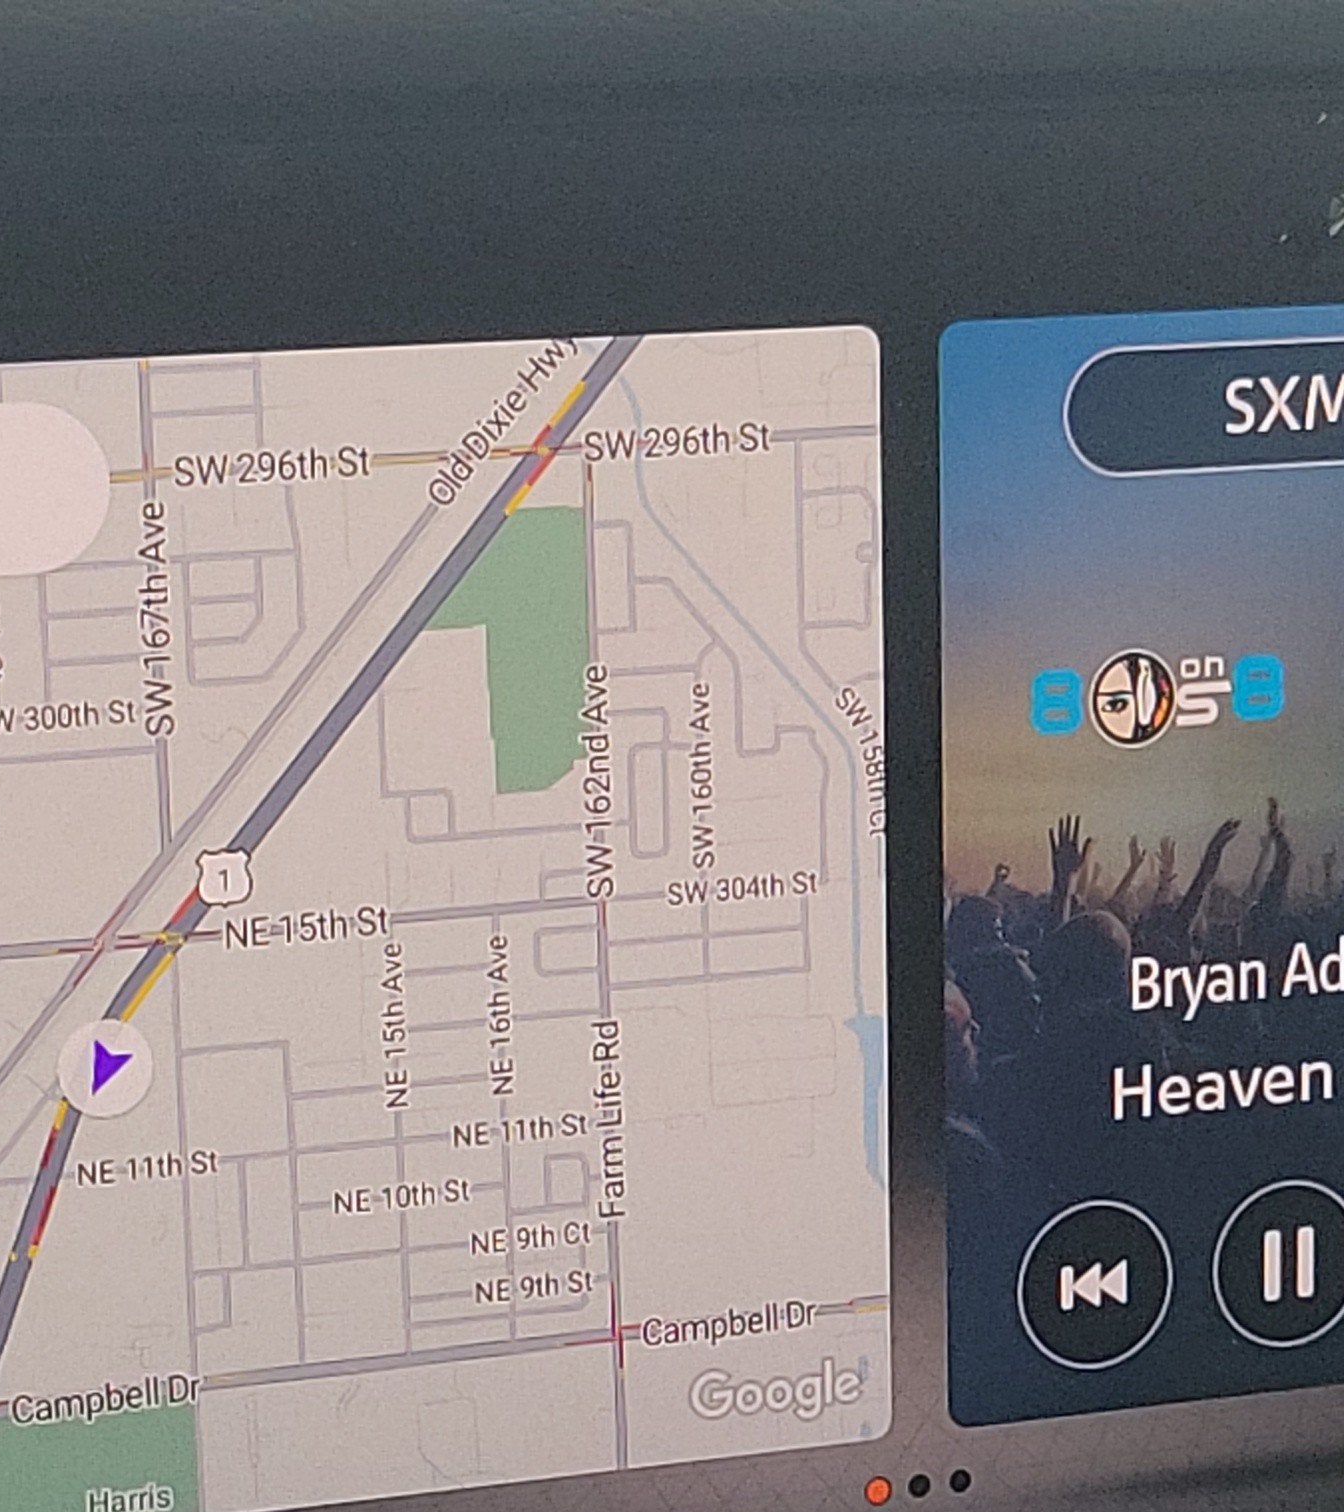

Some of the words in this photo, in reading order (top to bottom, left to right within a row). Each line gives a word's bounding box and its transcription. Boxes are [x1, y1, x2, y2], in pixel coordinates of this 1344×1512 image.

[429, 452, 474, 505] Old
[462, 390, 526, 460] Dixie
[518, 339, 578, 392] Hwy
[585, 431, 636, 461] SW
[643, 425, 730, 458] 296th
[739, 423, 770, 451] St
[174, 454, 228, 487] SW
[236, 447, 327, 483] 296th
[338, 447, 370, 477] St
[138, 502, 166, 563] Ave
[140, 573, 170, 667] 167th
[144, 673, 175, 736] SW
[582, 665, 608, 725] Ave
[689, 683, 709, 731] Ave
[836, 688, 872, 727] SW
[1232, 653, 1285, 721] 8
[24, 704, 100, 730] 300th
[109, 702, 136, 727] St
[582, 735, 611, 834] 162nd
[689, 741, 712, 815] 160th
[692, 825, 714, 869] SW
[220, 869, 230, 890] 1
[586, 845, 614, 898] SW
[668, 882, 707, 905] SW
[717, 873, 784, 900] 304th
[793, 871, 818, 895] St
[226, 917, 270, 949] NE
[279, 909, 347, 943] 15th
[357, 906, 387, 936] St
[382, 943, 404, 994] Ave
[488, 935, 509, 982] Ave
[1131, 956, 1266, 1022] Bryan
[381, 1002, 406, 1057] 15th
[488, 991, 511, 1048] 16th
[591, 1021, 620, 1062] Rd
[385, 1069, 408, 1108] NE
[490, 1057, 513, 1095] NE
[594, 1071, 622, 1128] Life
[1111, 1058, 1333, 1122] Heaven
[453, 1124, 489, 1147] NE
[502, 1118, 553, 1141] 11th
[562, 1115, 588, 1138] St
[77, 1161, 115, 1186] NE
[128, 1153, 182, 1179] 11th
[192, 1151, 218, 1175] St
[598, 1136, 626, 1218] Farm
[333, 1190, 371, 1214] NE
[382, 1182, 435, 1209] 10th
[444, 1179, 469, 1202] St
[471, 1229, 506, 1255] NE
[516, 1225, 554, 1249] 9th
[564, 1222, 590, 1245] Ct
[475, 1280, 510, 1303] NE
[520, 1274, 557, 1299] 9th
[568, 1272, 593, 1294] St
[642, 1311, 779, 1346] Campbell
[786, 1302, 817, 1330] Dr
[11, 1382, 160, 1425] Campbell
[167, 1375, 201, 1405] Dr
[690, 1358, 860, 1421] Google
